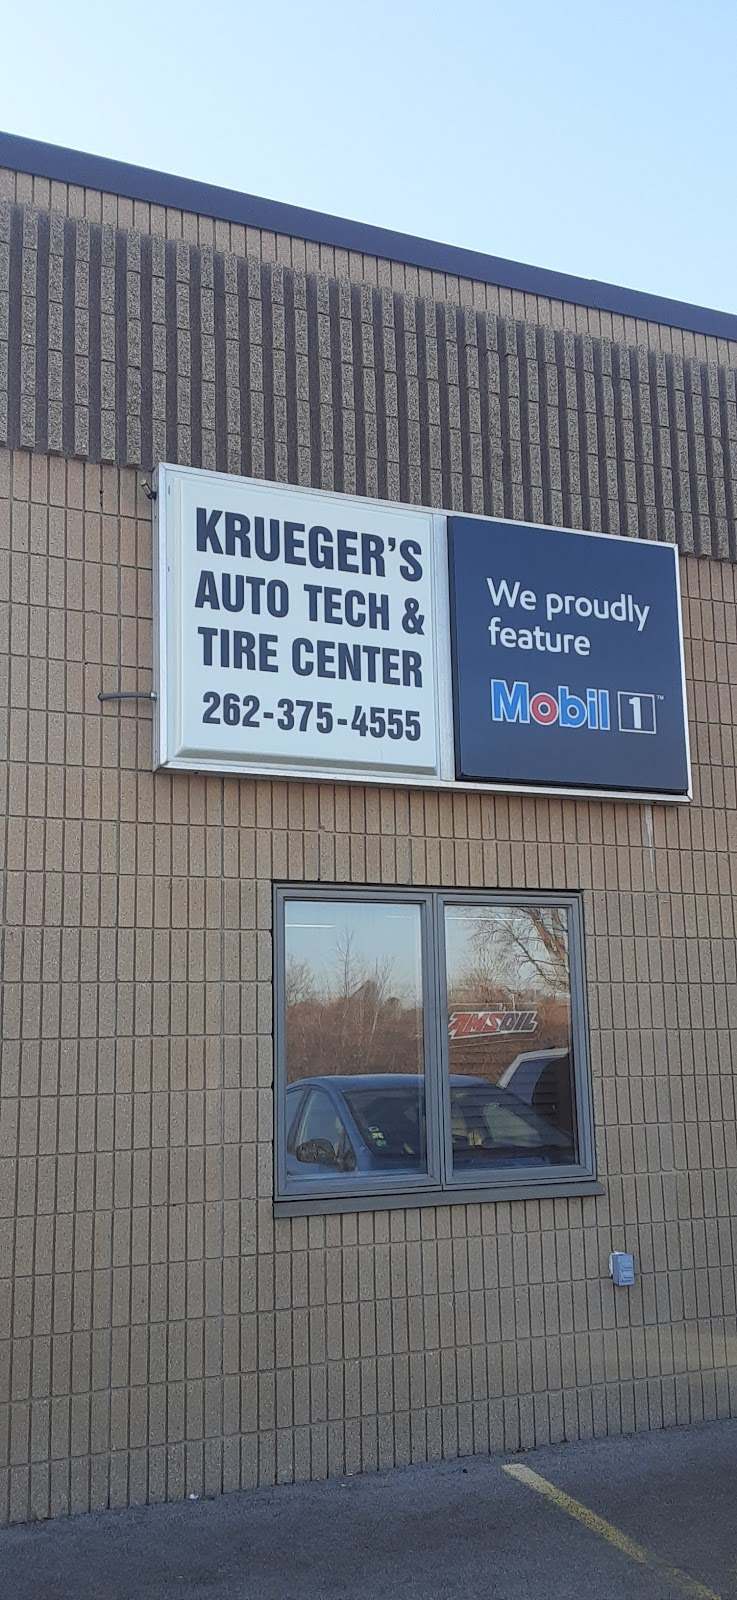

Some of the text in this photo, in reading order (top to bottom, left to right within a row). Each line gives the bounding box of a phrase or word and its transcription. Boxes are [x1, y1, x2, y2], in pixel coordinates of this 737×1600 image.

[196, 507, 423, 582] KRUEGER'S
[194, 570, 425, 635] AUTO TECH &
[486, 577, 650, 631] We proudly
[197, 626, 423, 688] TIRE CENTER
[488, 616, 591, 655] feature
[202, 691, 421, 741] 262-375-4555
[490, 678, 611, 731] Mobil
[448, 1011, 538, 1039] AMSOIL
